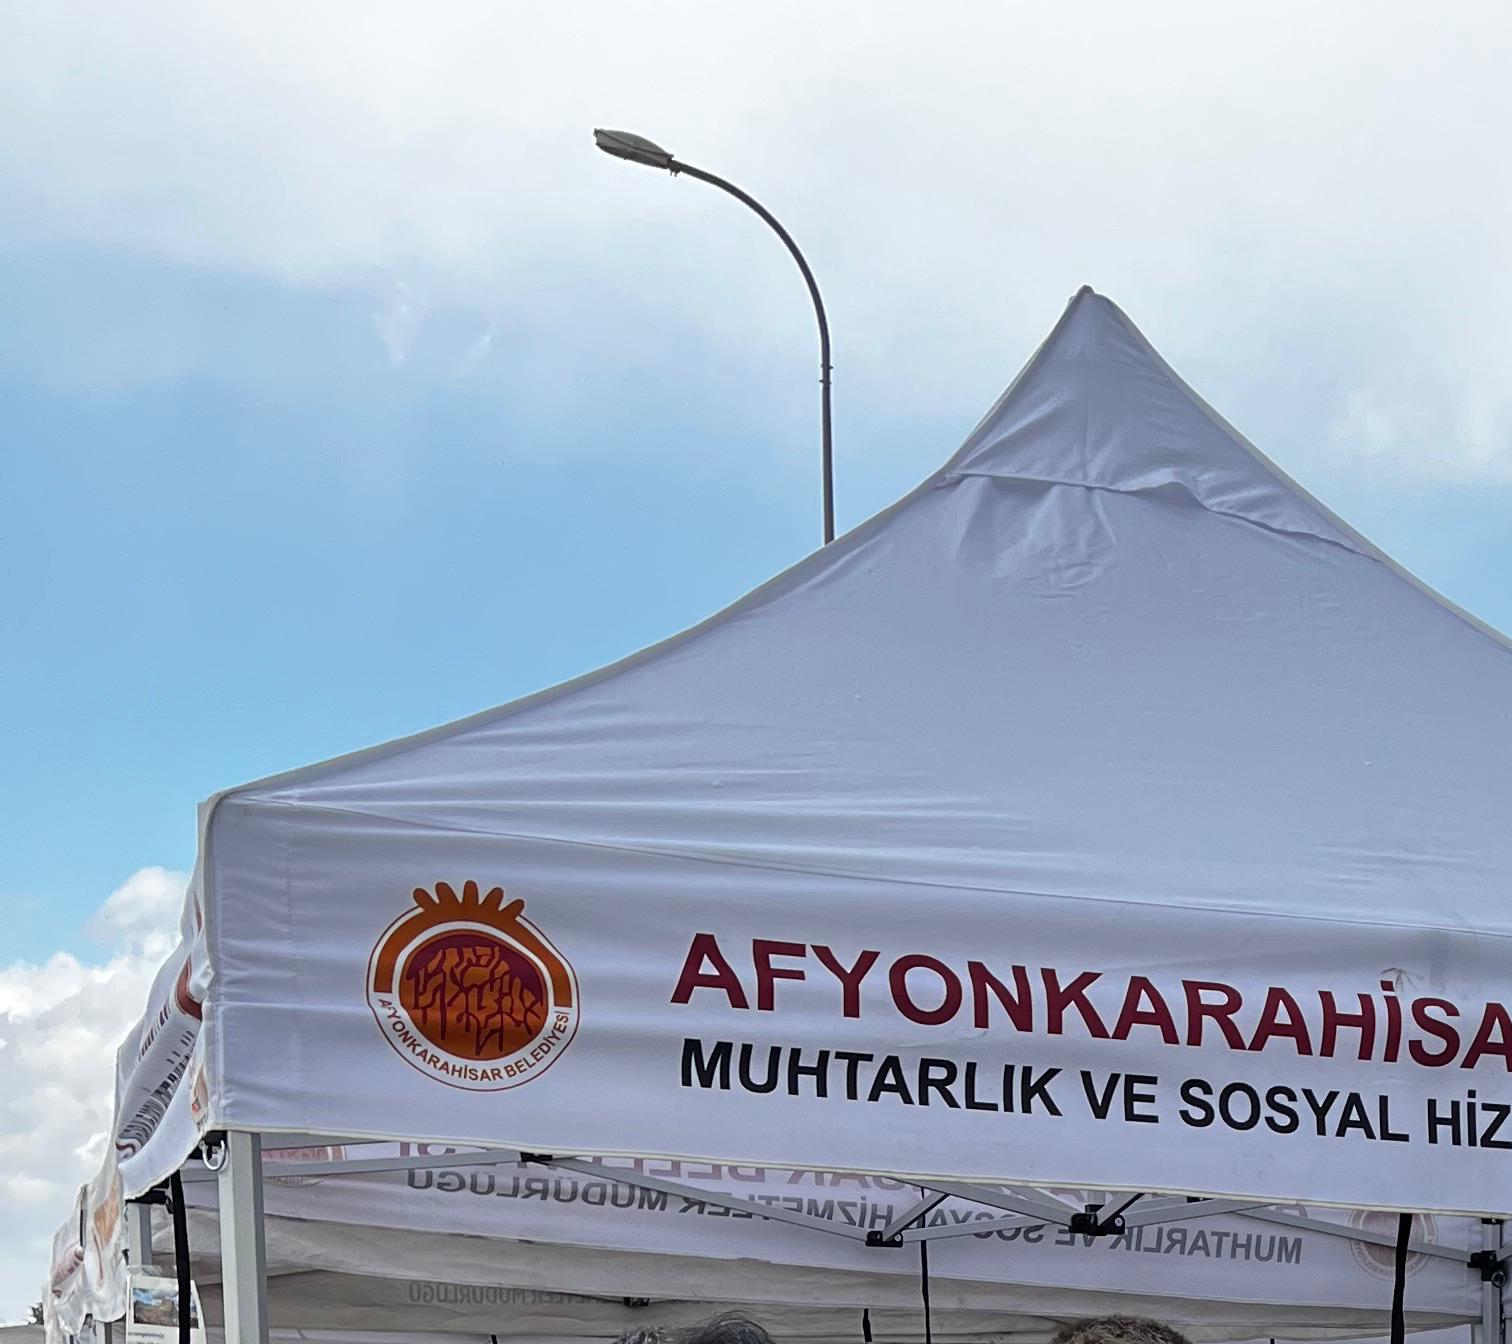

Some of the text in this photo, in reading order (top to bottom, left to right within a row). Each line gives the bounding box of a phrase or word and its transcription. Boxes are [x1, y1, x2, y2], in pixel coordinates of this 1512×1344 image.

[681, 1038, 1063, 1117] MUHTARLIK
[1080, 1070, 1159, 1123] VE
[1179, 1078, 1410, 1142] SOSYAL
